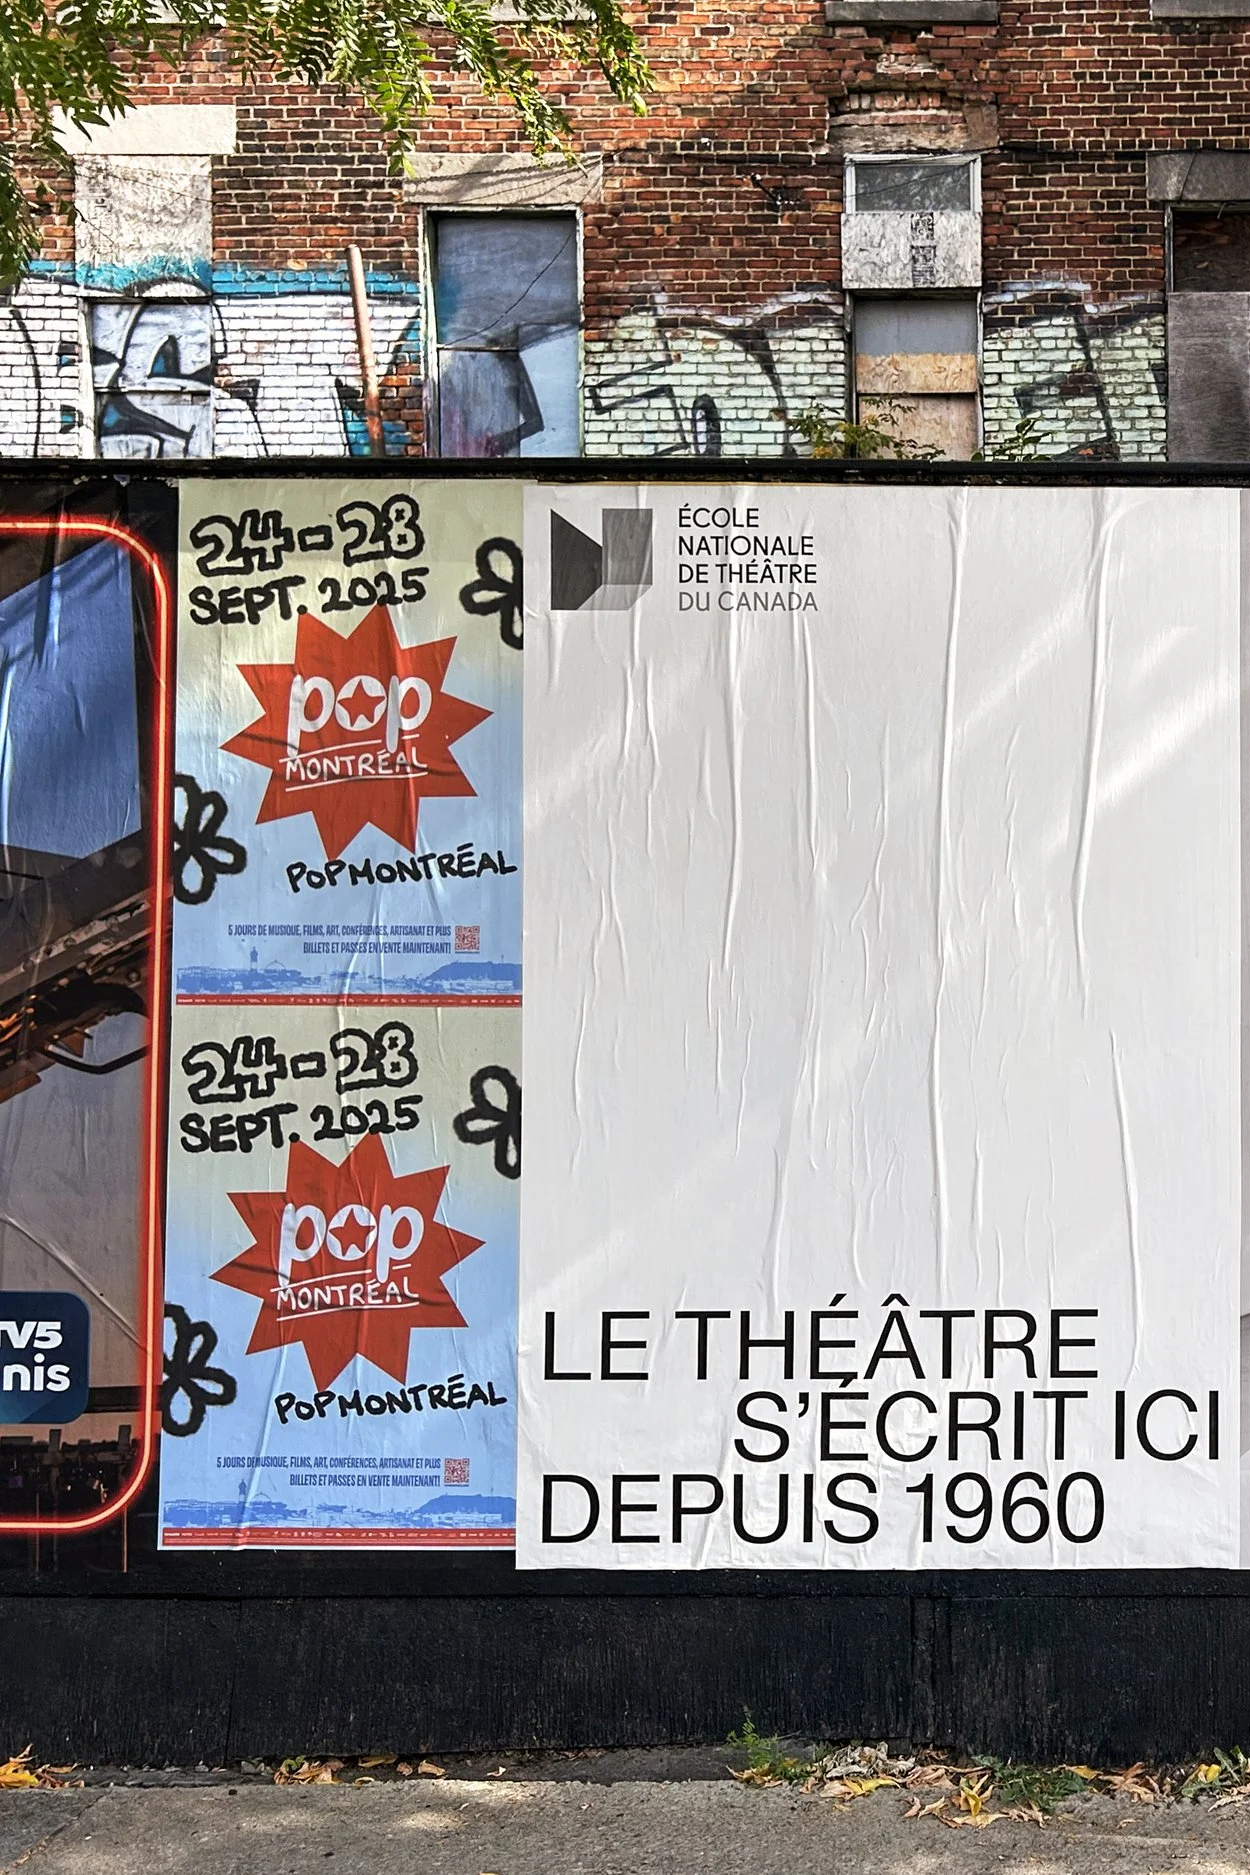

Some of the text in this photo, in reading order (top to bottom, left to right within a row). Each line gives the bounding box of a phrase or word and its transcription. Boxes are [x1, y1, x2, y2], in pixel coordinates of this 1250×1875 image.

[678, 503, 760, 528] ÉCOLE
[190, 493, 425, 577] 24-28
[678, 536, 814, 556] NATIONALE
[678, 559, 817, 584] DE THÉÂTRE
[190, 567, 429, 625] SEPT. 2025
[679, 591, 818, 611] DU CANADA
[285, 747, 427, 781] MONTRÉAL
[228, 925, 233, 936] 5
[234, 925, 257, 936] JOURS
[258, 925, 267, 936] DE
[268, 925, 301, 936] MUSIQUE,
[303, 925, 325, 936] FILMS,
[326, 925, 340, 936] ART,
[390, 925, 425, 936] ARTISANAT
[426, 925, 434, 936] ET
[435, 925, 451, 936] PLUS
[303, 942, 330, 954] BILLETS
[331, 942, 339, 954] ET
[341, 942, 367, 954] PASSES
[368, 942, 378, 954] EN
[380, 942, 401, 954] VENTE
[182, 1021, 418, 1103] 24-28
[180, 1094, 423, 1153] SEPT. 2025
[276, 1276, 419, 1311] MONTRÉAL
[543, 1293, 1099, 1381] LE THÉÂTRE
[1113, 1389, 1222, 1462] ICI
[216, 1457, 221, 1469] 5
[222, 1457, 246, 1469] JOURS
[290, 1457, 312, 1469] FILMS,
[314, 1457, 328, 1469] ART,
[330, 1457, 378, 1469] CONFÉRENCES,
[380, 1457, 414, 1469] ARTISANAT
[416, 1457, 423, 1469] ET
[424, 1457, 441, 1469] PLUS
[290, 1474, 317, 1487] BILLETS
[318, 1474, 327, 1487] ET
[328, 1474, 355, 1487] PASSES
[357, 1474, 367, 1487] EN
[368, 1474, 390, 1487] VENTE
[541, 1471, 1105, 1546] DEPUIS 1960
